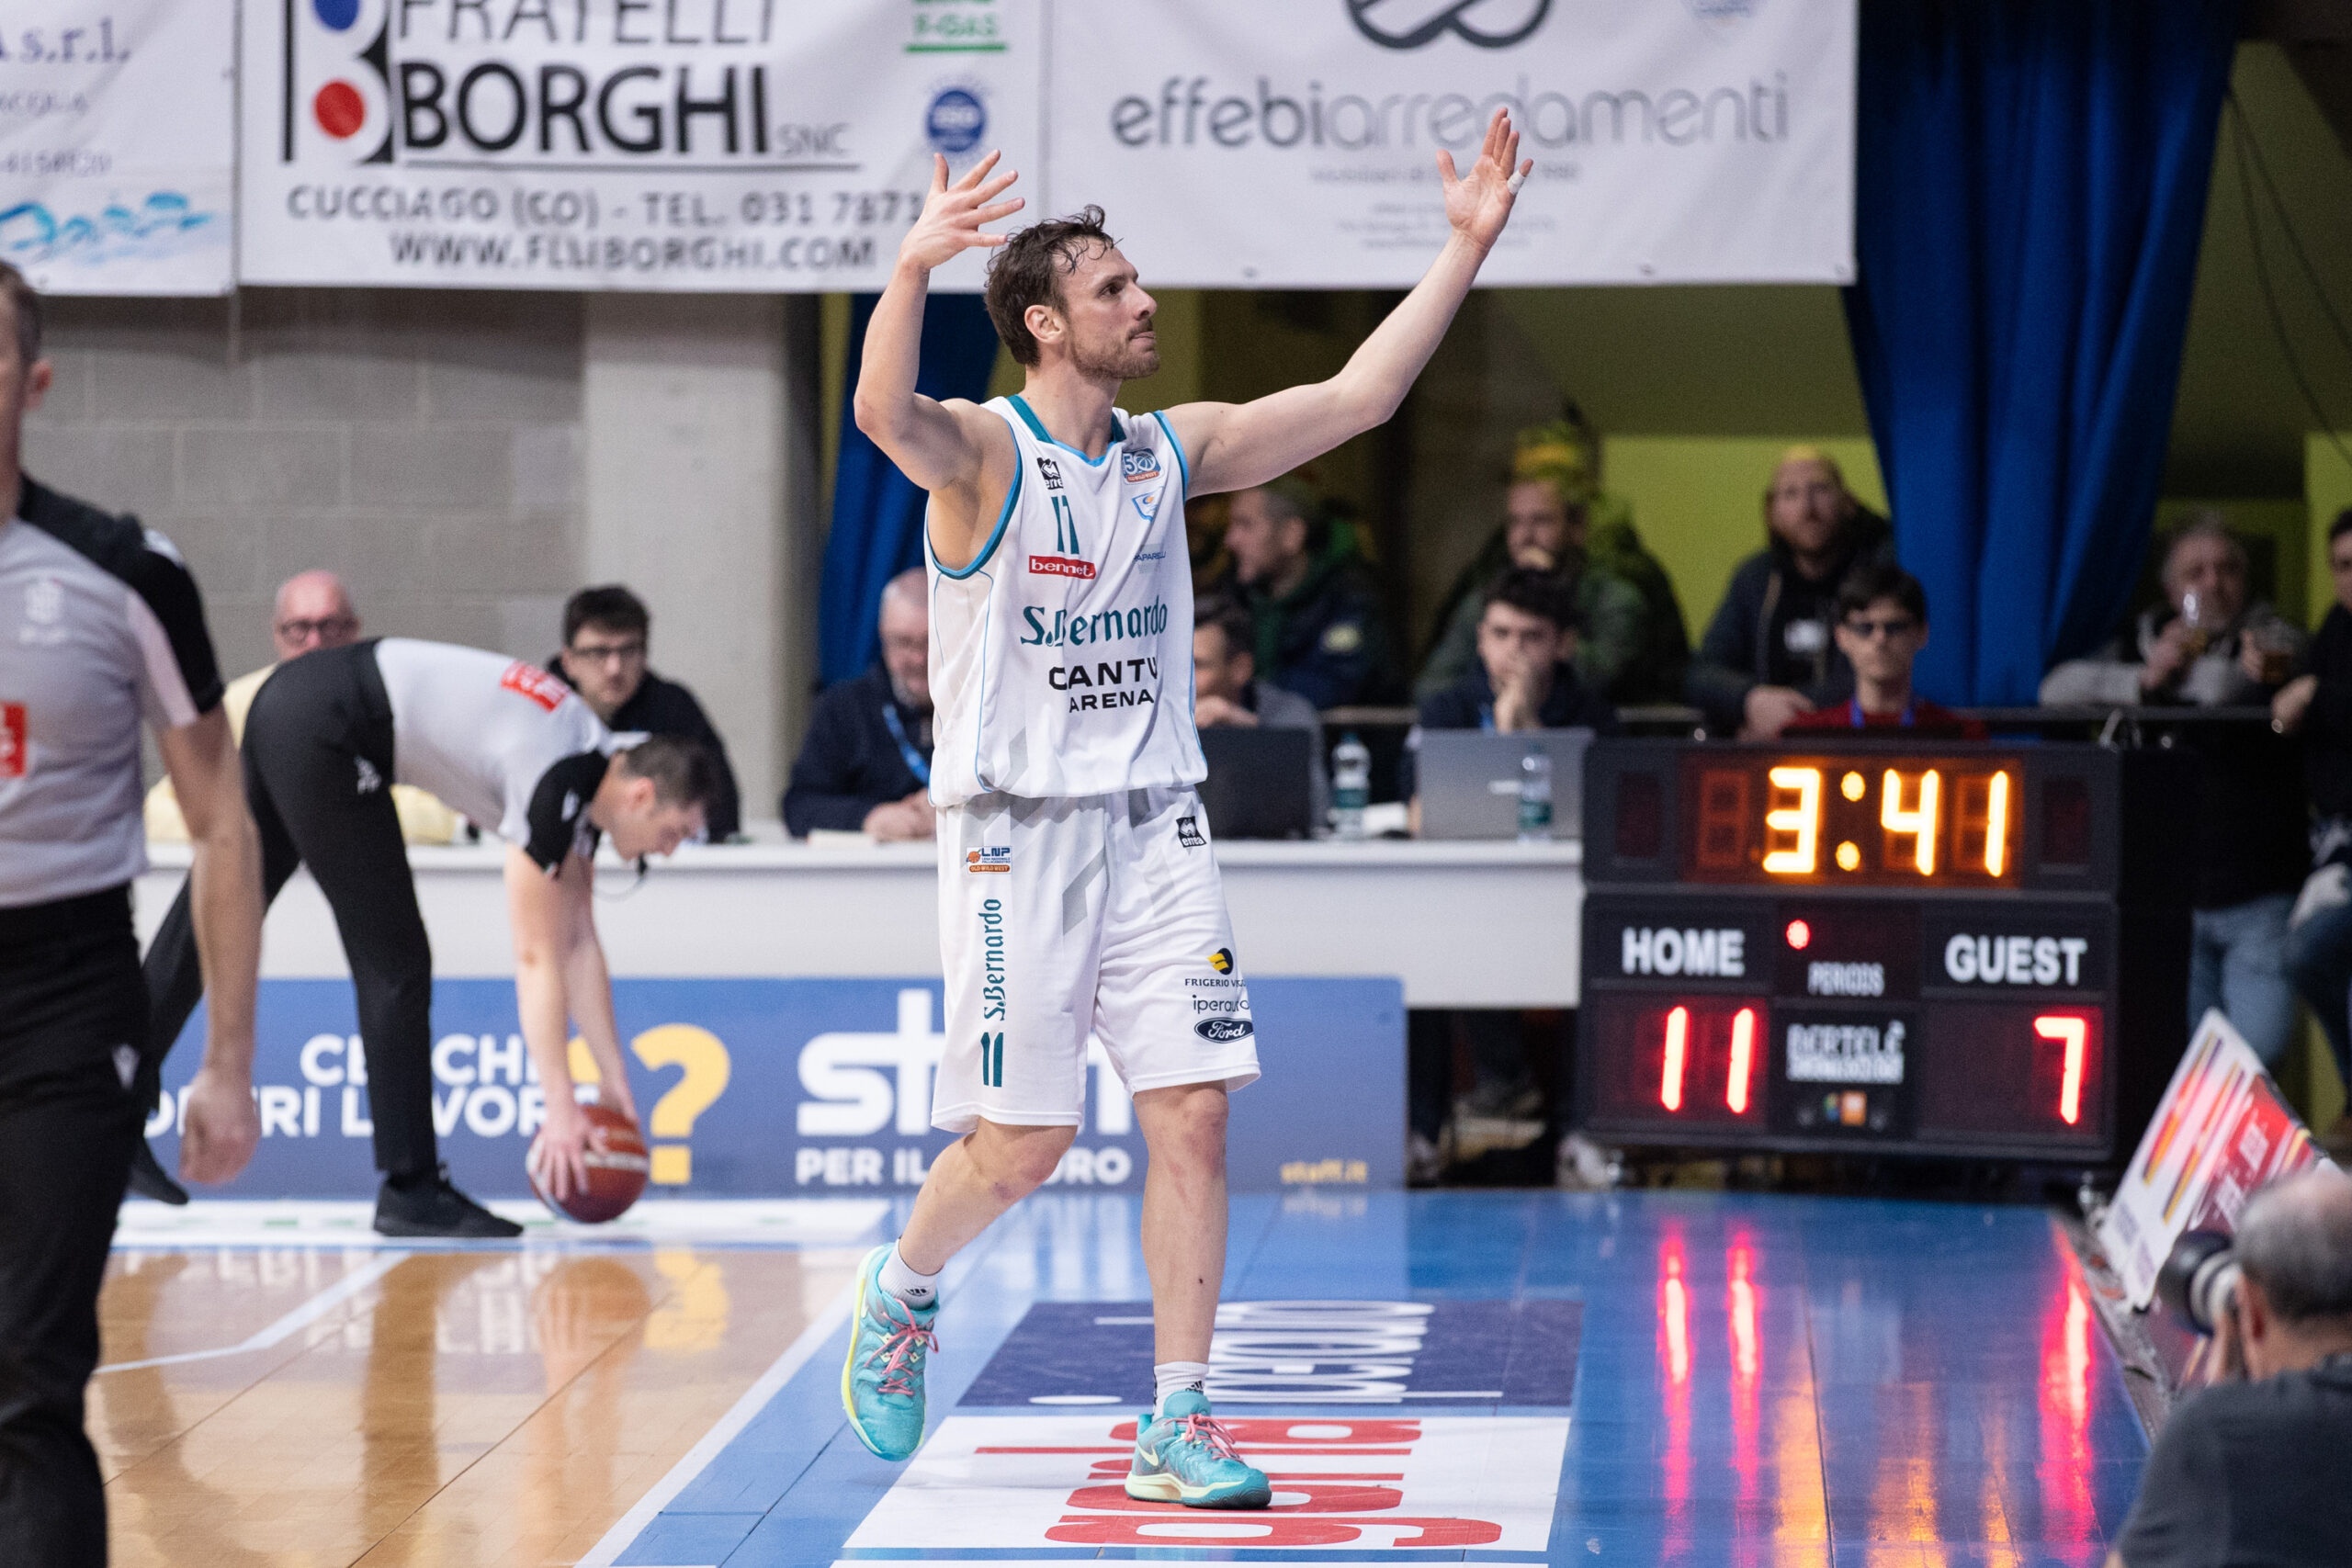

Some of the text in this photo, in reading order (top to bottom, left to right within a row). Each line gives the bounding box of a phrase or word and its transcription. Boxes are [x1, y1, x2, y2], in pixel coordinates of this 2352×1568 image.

[400, 59, 768, 154] BORGHI
[287, 184, 499, 221] CUCCIAGO
[511, 186, 596, 231] (CO)
[643, 191, 724, 227] TEL.
[739, 191, 815, 226] 031
[831, 190, 922, 226] 7871
[1050, 494, 1080, 555] 11
[1031, 558, 1091, 577] bennet
[1020, 595, 1168, 648] S.Bernardo
[1069, 688, 1155, 714] ARENA
[1762, 766, 2009, 877] 3:41
[981, 847, 1011, 857] LNP
[978, 898, 1006, 1021] S.Bernardo
[1622, 928, 1746, 976] HOME
[1944, 933, 2088, 986] GUEST
[1185, 978, 1229, 987] FRIGERIO
[1207, 1021, 1246, 1038] Ford
[980, 1032, 1004, 1088] 11
[1661, 1006, 1755, 1113] 11
[2033, 1016, 2087, 1124] 7
[796, 1148, 885, 1185] PER
